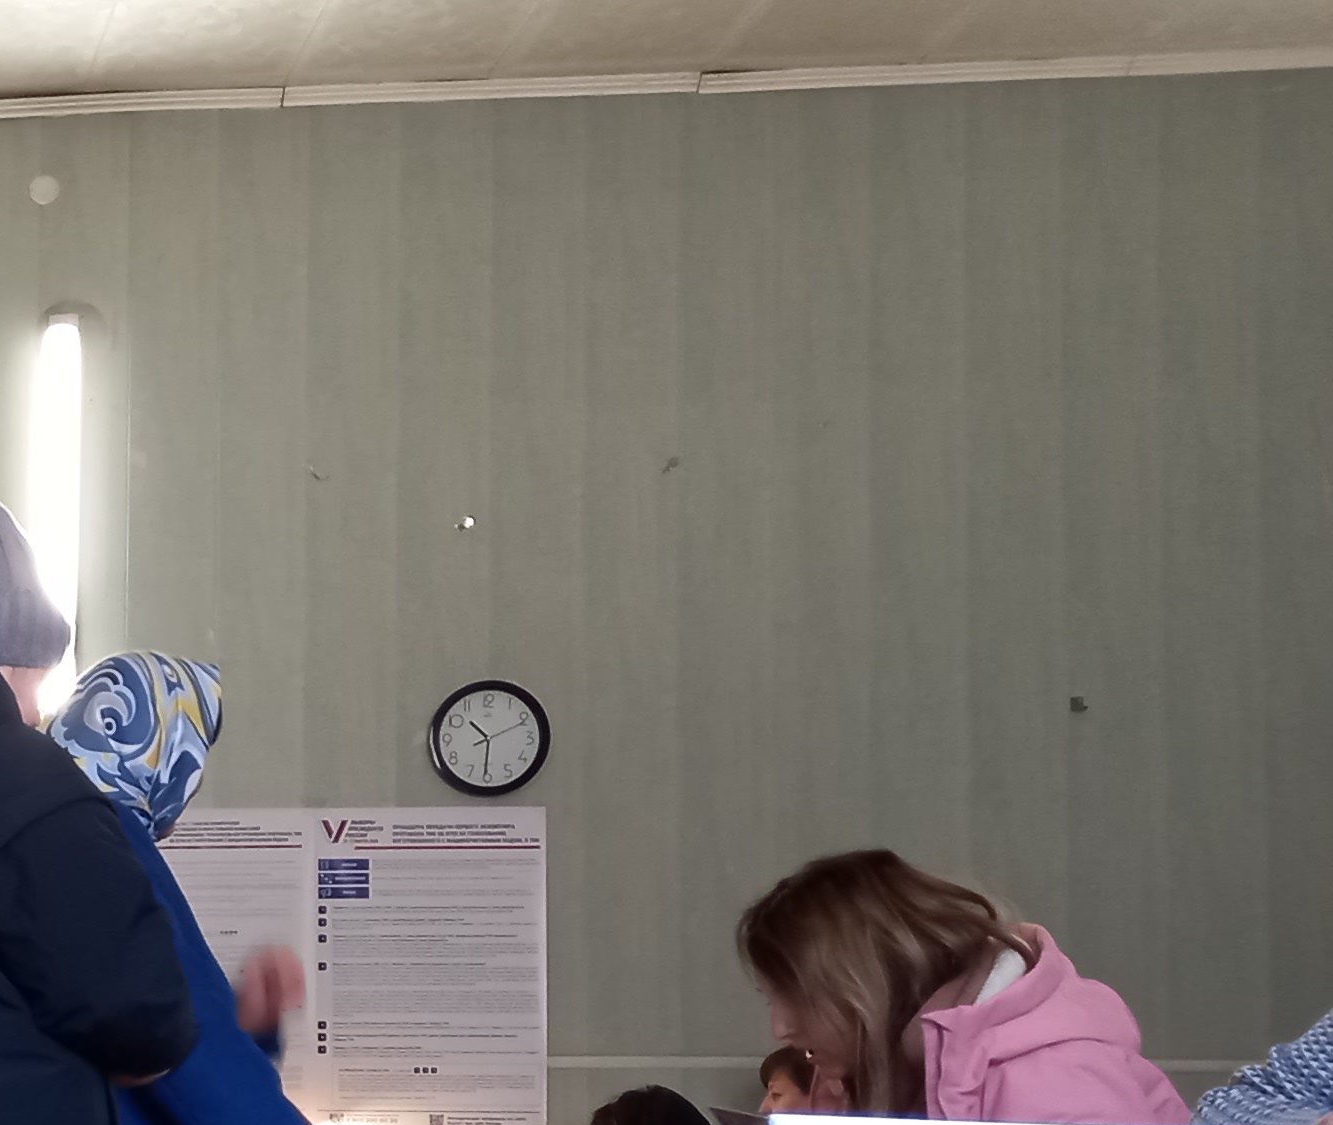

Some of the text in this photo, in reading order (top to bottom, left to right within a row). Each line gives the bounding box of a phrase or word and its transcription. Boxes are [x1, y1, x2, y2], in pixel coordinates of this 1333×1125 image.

[463, 699, 471, 712] 11
[483, 693, 494, 708] 12
[448, 714, 464, 728] 10
[519, 711, 529, 726] 2
[442, 733, 452, 747] 9
[526, 730, 535, 745] 3
[449, 751, 458, 765] 8
[518, 750, 527, 763] 4
[466, 764, 475, 778] 7
[503, 763, 513, 778] 5
